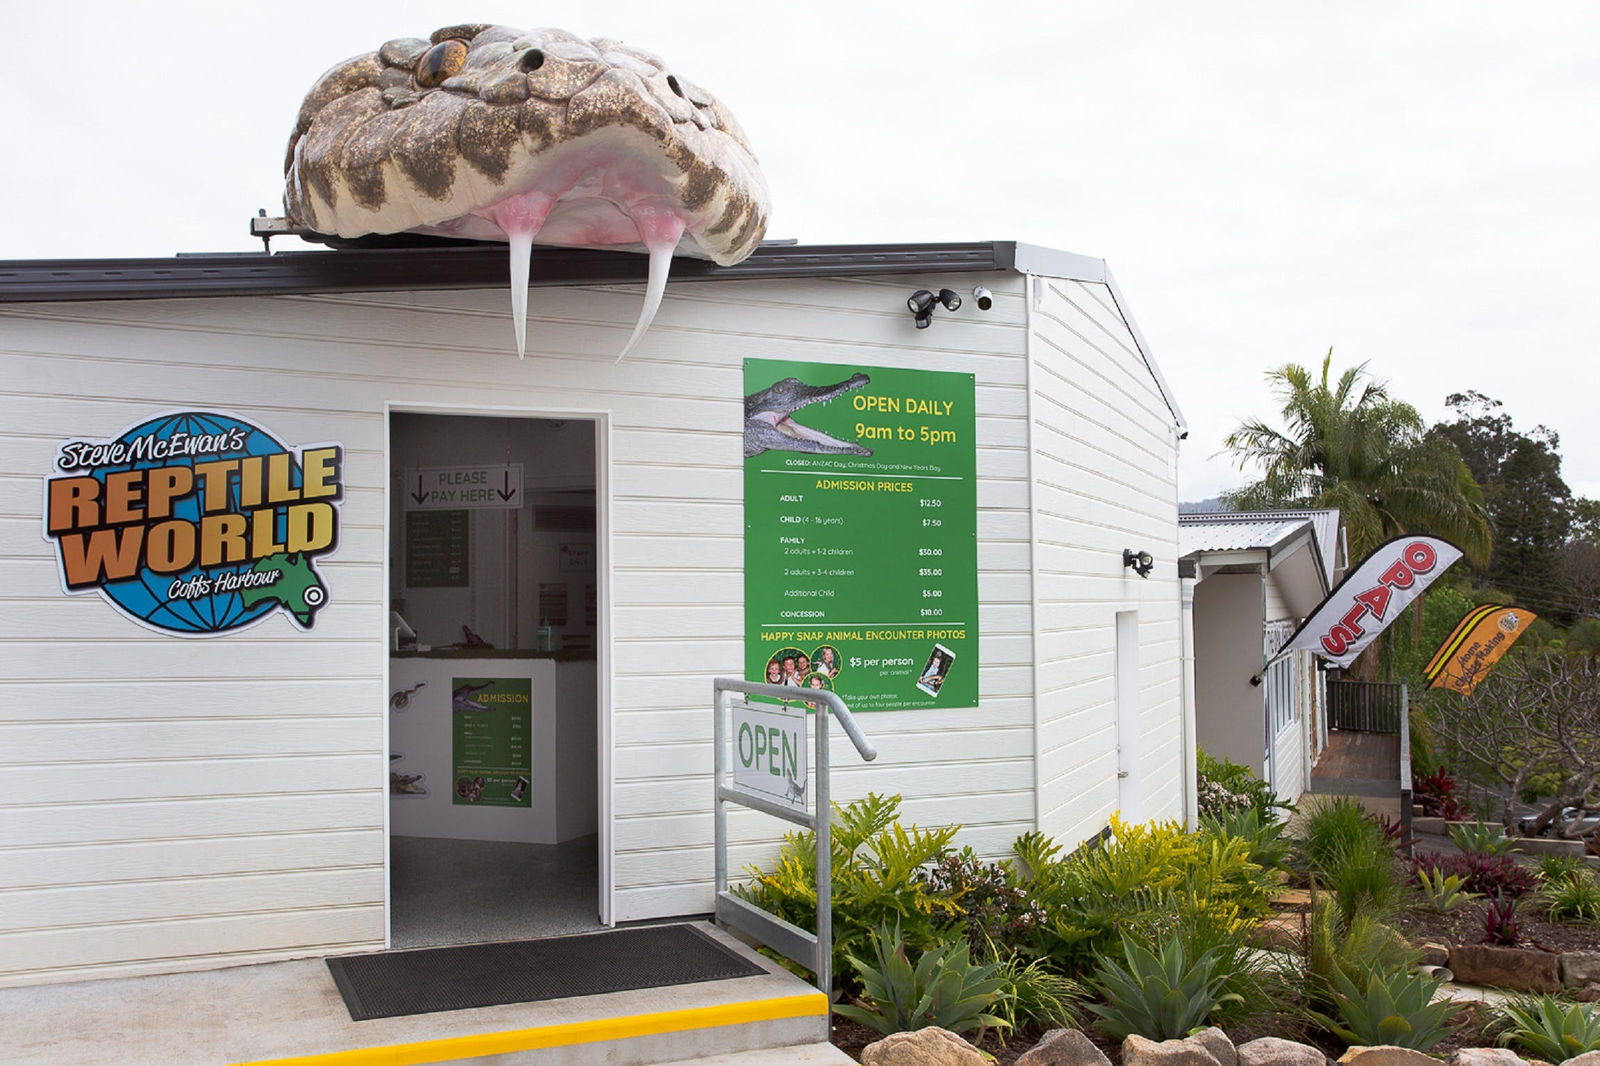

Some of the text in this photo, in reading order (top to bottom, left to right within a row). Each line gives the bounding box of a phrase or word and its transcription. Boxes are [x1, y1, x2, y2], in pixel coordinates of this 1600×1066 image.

[853, 395, 953, 416] OPEN DAILY
[855, 423, 956, 446] 9am to 5pm
[58, 427, 247, 470] Steve McEwan's
[847, 461, 876, 469] Christmas
[876, 463, 888, 471] Day
[929, 465, 941, 473] Day
[439, 471, 488, 485] PLEASE
[49, 447, 338, 532] REPTILE
[815, 479, 913, 493] ADMISSION PRICES
[431, 488, 495, 503] PAY HERE
[920, 498, 942, 508] $12.50
[779, 515, 802, 523] CHILD
[822, 517, 844, 526] years)
[922, 518, 942, 528] $7.50
[60, 502, 334, 586] WORLD
[780, 536, 806, 544] FAMILY
[784, 547, 789, 555] 2
[784, 568, 789, 576] 2
[790, 568, 811, 576] adults
[829, 568, 854, 576] children
[919, 568, 942, 577] $35.00
[168, 568, 281, 600] Coffs Harbour
[784, 589, 835, 598] Additional Child
[922, 589, 942, 599] $5.00
[1319, 540, 1437, 656] OPALS
[780, 610, 825, 618] CONCESSION
[920, 608, 943, 617] $10.00
[761, 630, 966, 641] HAPPY SNAP ANIMAL ENCOUNTER PHOTOS
[1476, 631, 1506, 660] Making
[849, 656, 914, 669] $5 per person
[477, 693, 529, 703] ADMISSION
[738, 721, 798, 781] OPEN
